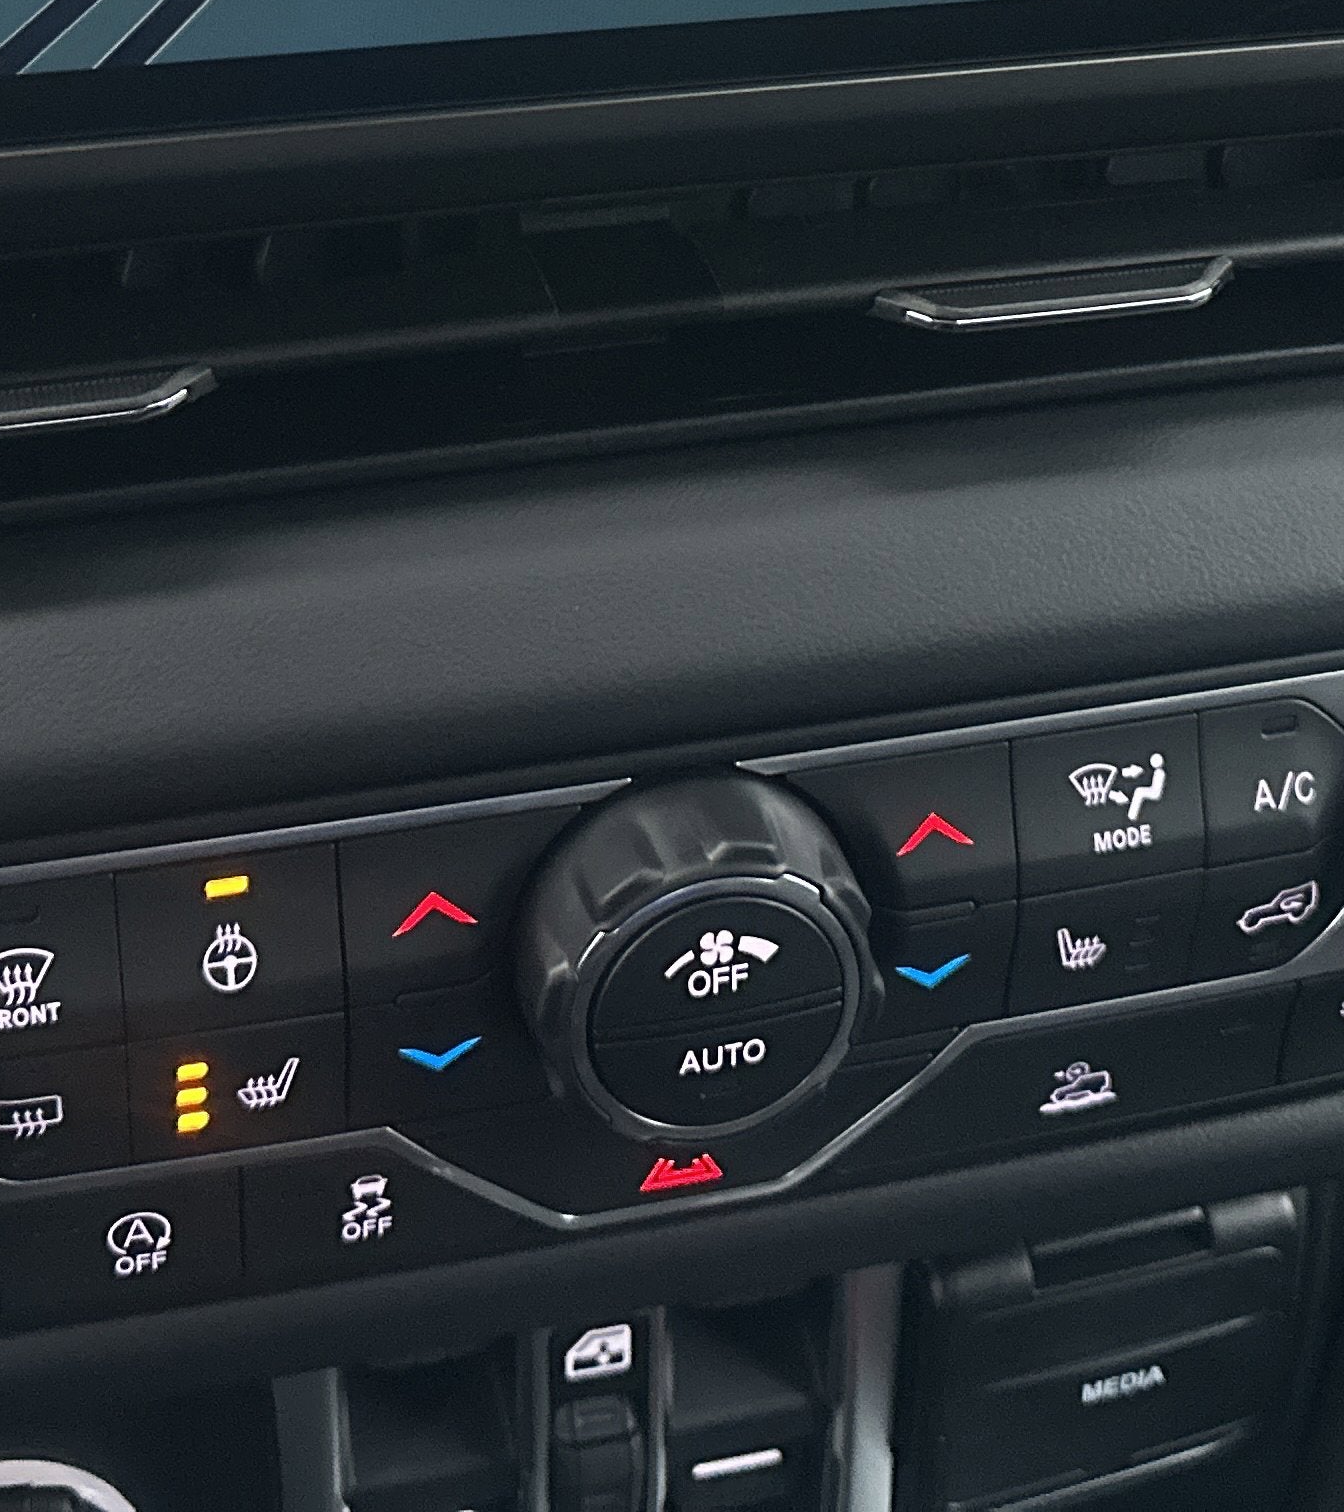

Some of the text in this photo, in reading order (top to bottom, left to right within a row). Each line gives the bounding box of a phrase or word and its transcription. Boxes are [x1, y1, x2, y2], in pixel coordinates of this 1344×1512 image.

[1254, 771, 1314, 811] A/C
[1094, 824, 1151, 852] MODE
[688, 962, 748, 997] OFF
[680, 1039, 765, 1075] AUTO
[342, 1212, 392, 1240] OFF
[112, 1248, 166, 1274] OFF
[1082, 1366, 1164, 1402] MEDIA
